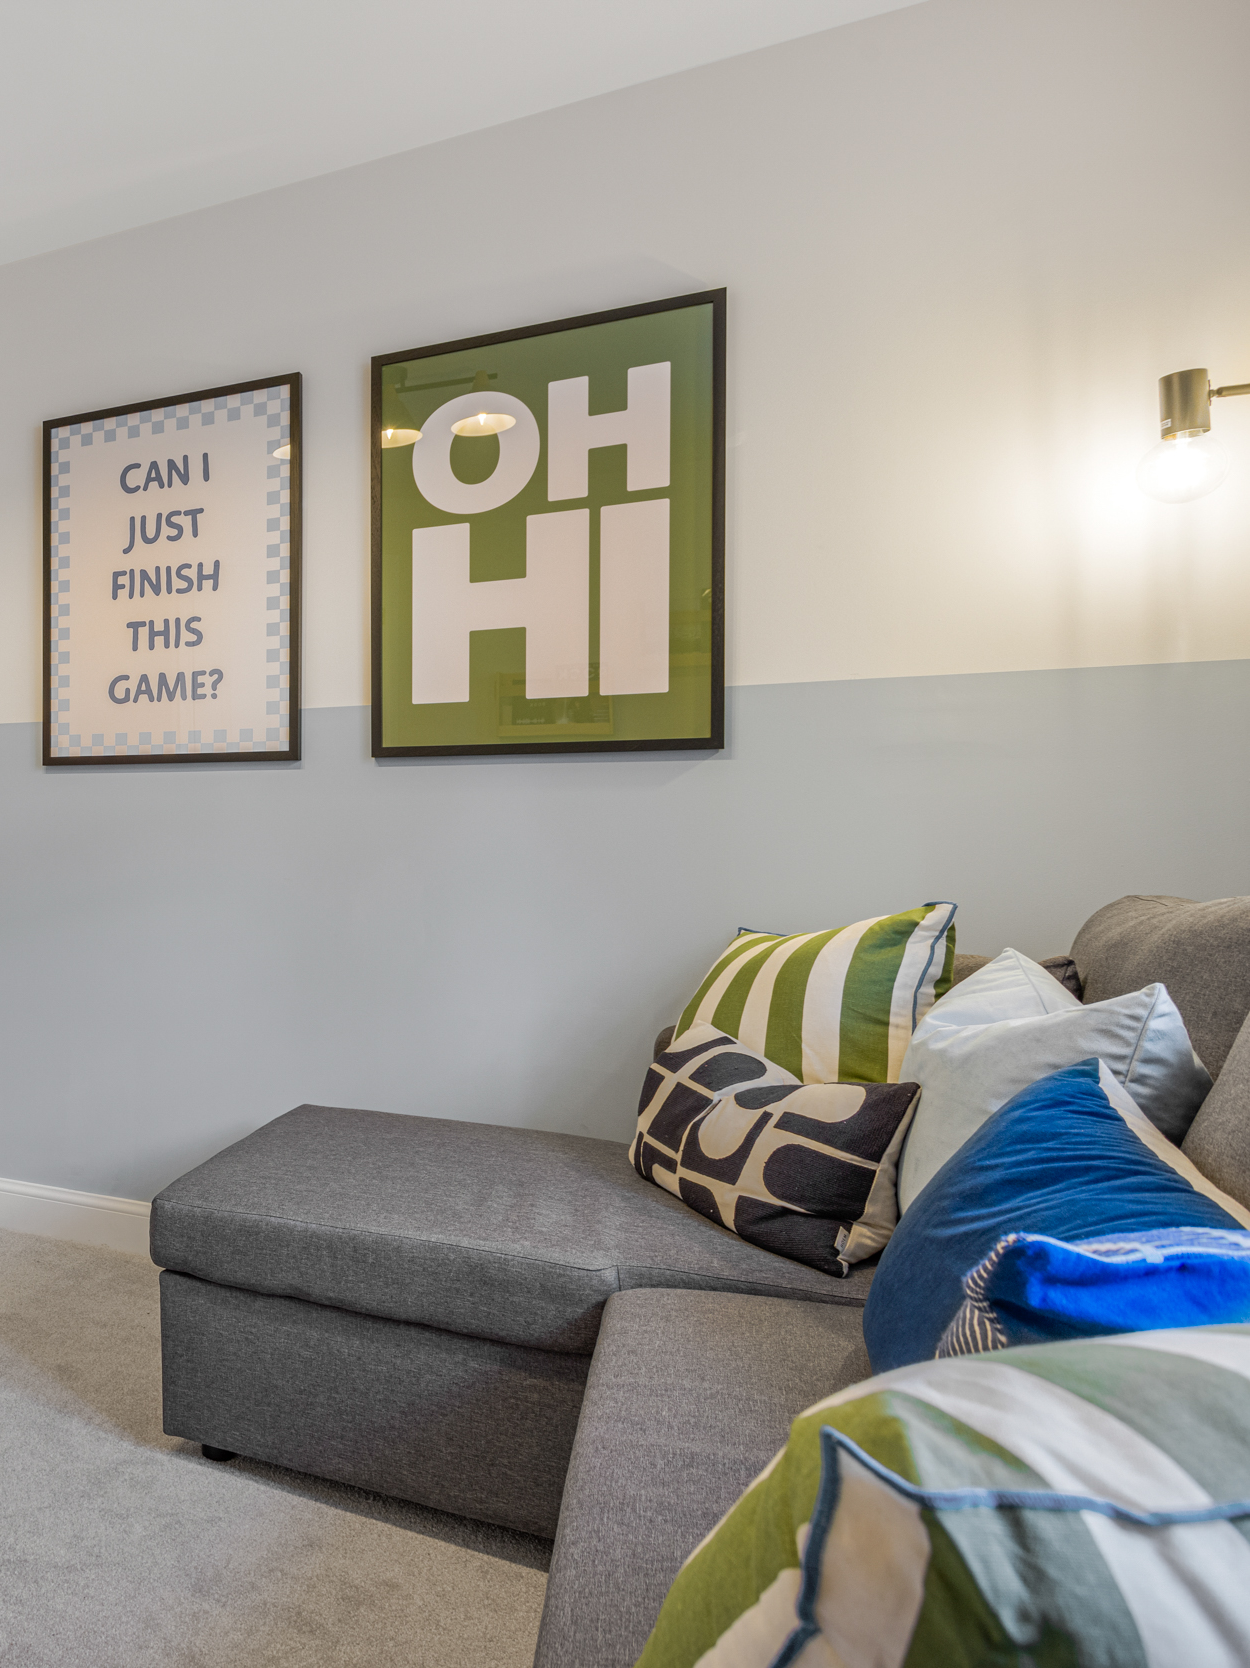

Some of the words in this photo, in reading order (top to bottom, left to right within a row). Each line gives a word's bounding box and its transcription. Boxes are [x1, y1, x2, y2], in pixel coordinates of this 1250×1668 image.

[412, 361, 671, 515] OH
[119, 454, 189, 494] CAN
[202, 452, 210, 482] I
[122, 507, 205, 555] JUST
[111, 560, 221, 601] FINISH
[412, 498, 670, 705] HI
[126, 616, 204, 652] THIS
[108, 668, 224, 704] GAME?
